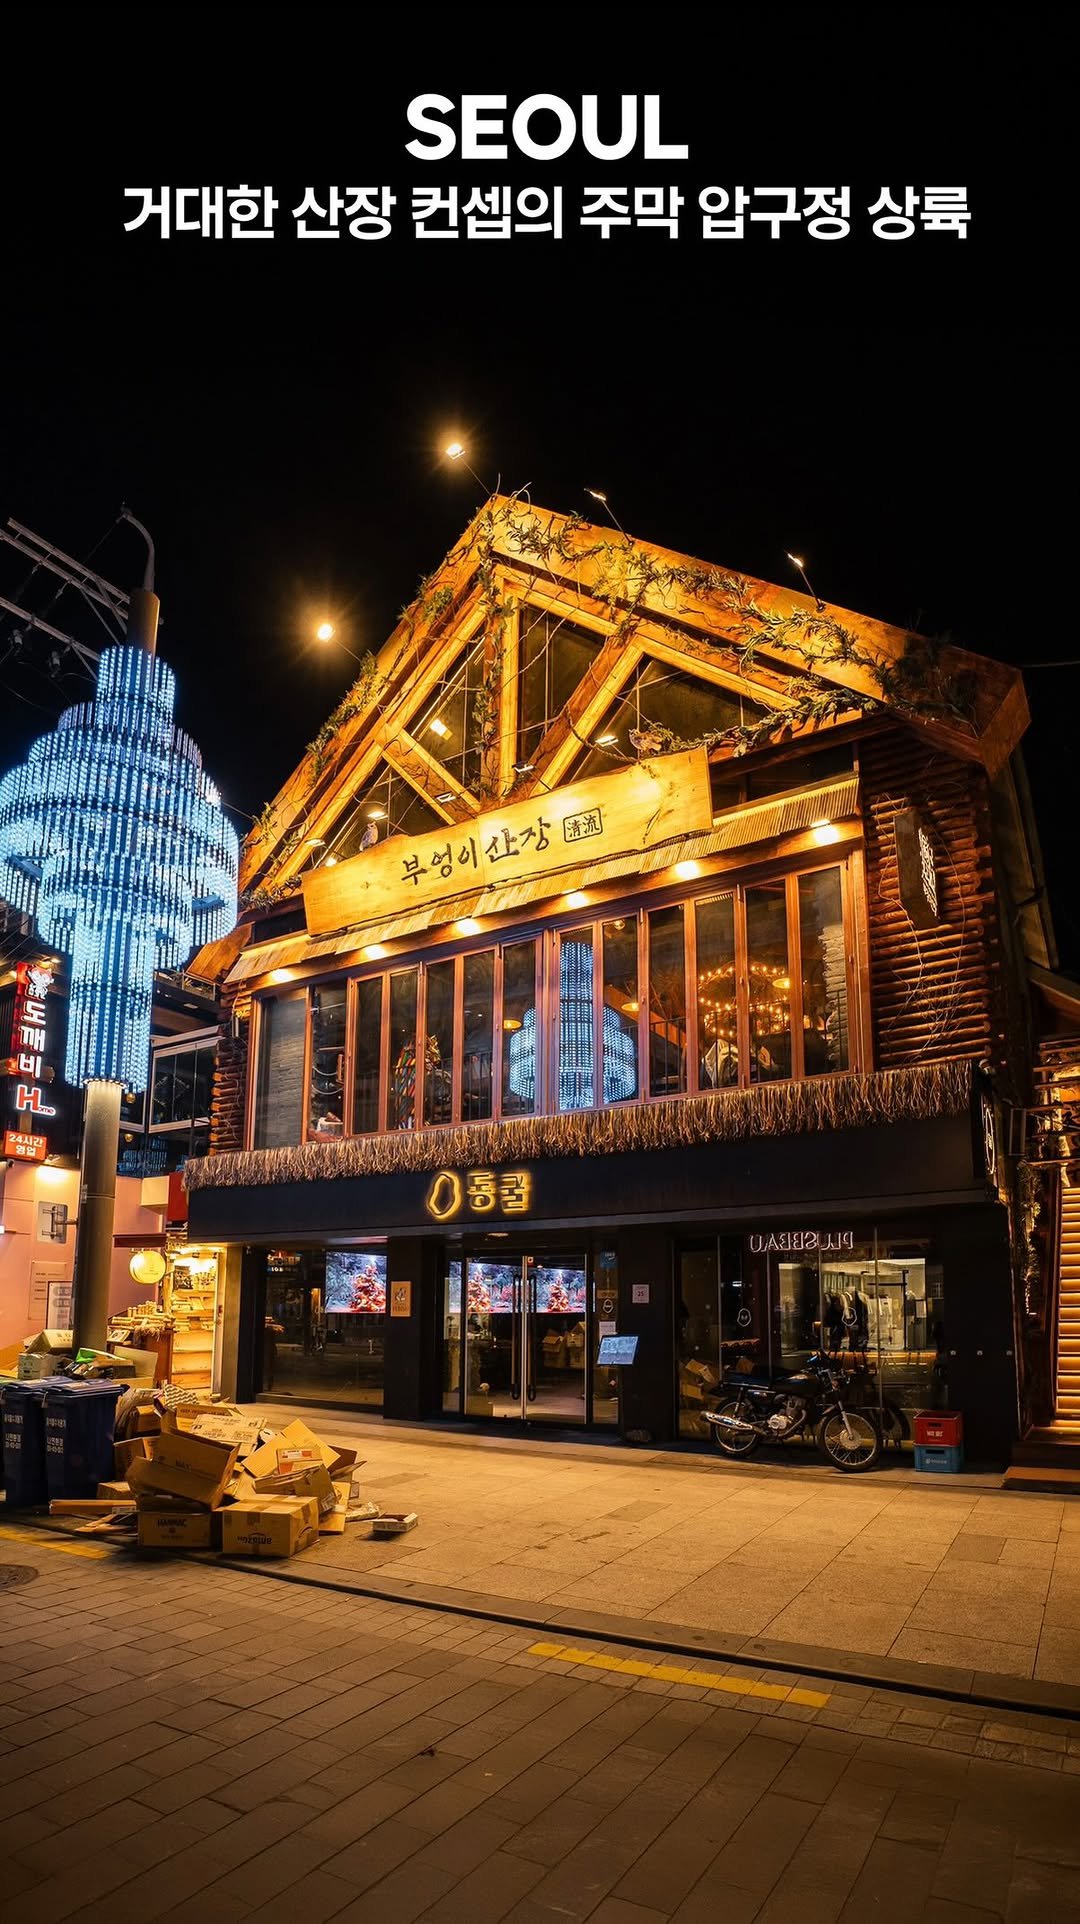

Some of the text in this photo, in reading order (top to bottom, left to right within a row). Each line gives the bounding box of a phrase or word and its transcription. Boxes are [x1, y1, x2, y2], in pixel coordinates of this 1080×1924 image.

[19, 1000, 46, 1079] 도깨비
[17, 1085, 56, 1115] Home
[9, 1133, 43, 1147] 24시간
[16, 1145, 36, 1156] 영업
